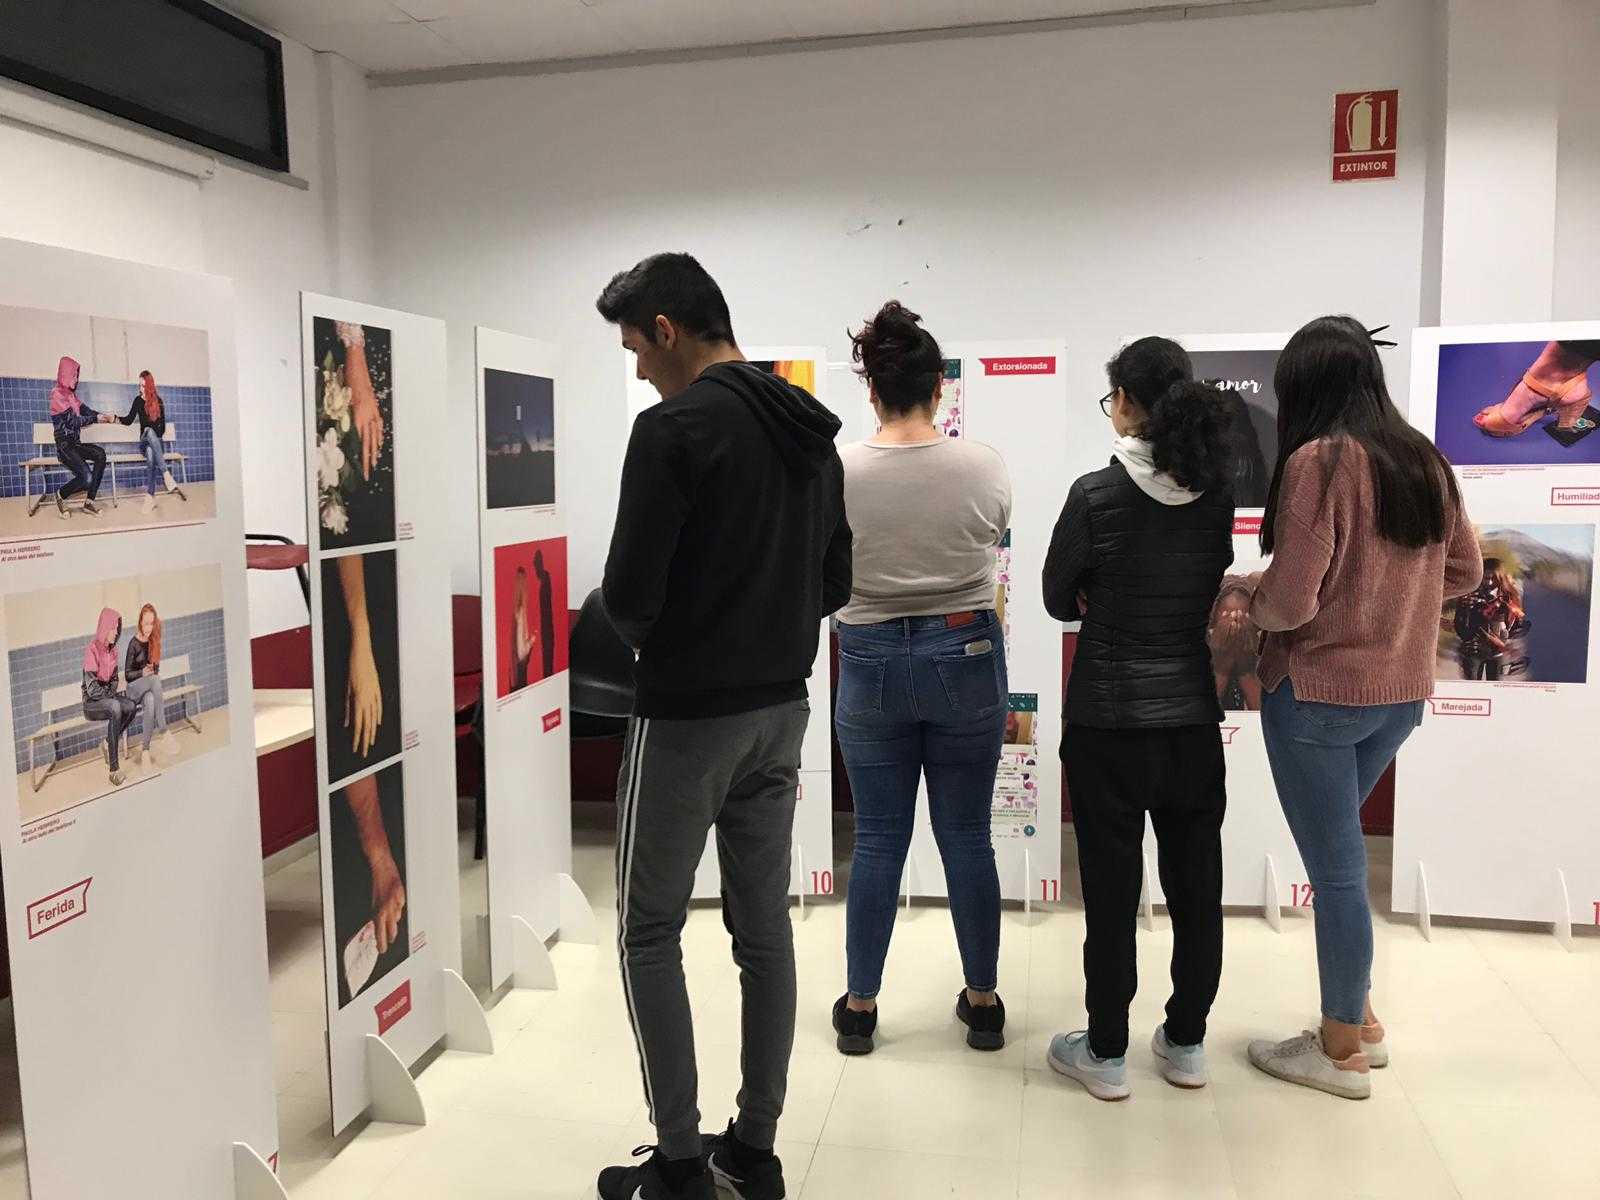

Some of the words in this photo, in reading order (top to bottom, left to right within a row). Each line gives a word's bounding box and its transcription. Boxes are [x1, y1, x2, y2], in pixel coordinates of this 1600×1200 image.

[1340, 161, 1387, 172] EXTINTOR
[992, 362, 1048, 371] Extorsionada
[1215, 379, 1262, 393] amor
[1557, 492, 1600, 501] Humiliad
[1234, 521, 1261, 530] Silenc
[1441, 702, 1483, 713] Marejada
[811, 870, 832, 894] 10
[1040, 879, 1058, 901] 11
[1291, 883, 1312, 907] 12
[37, 898, 75, 925] Ferida
